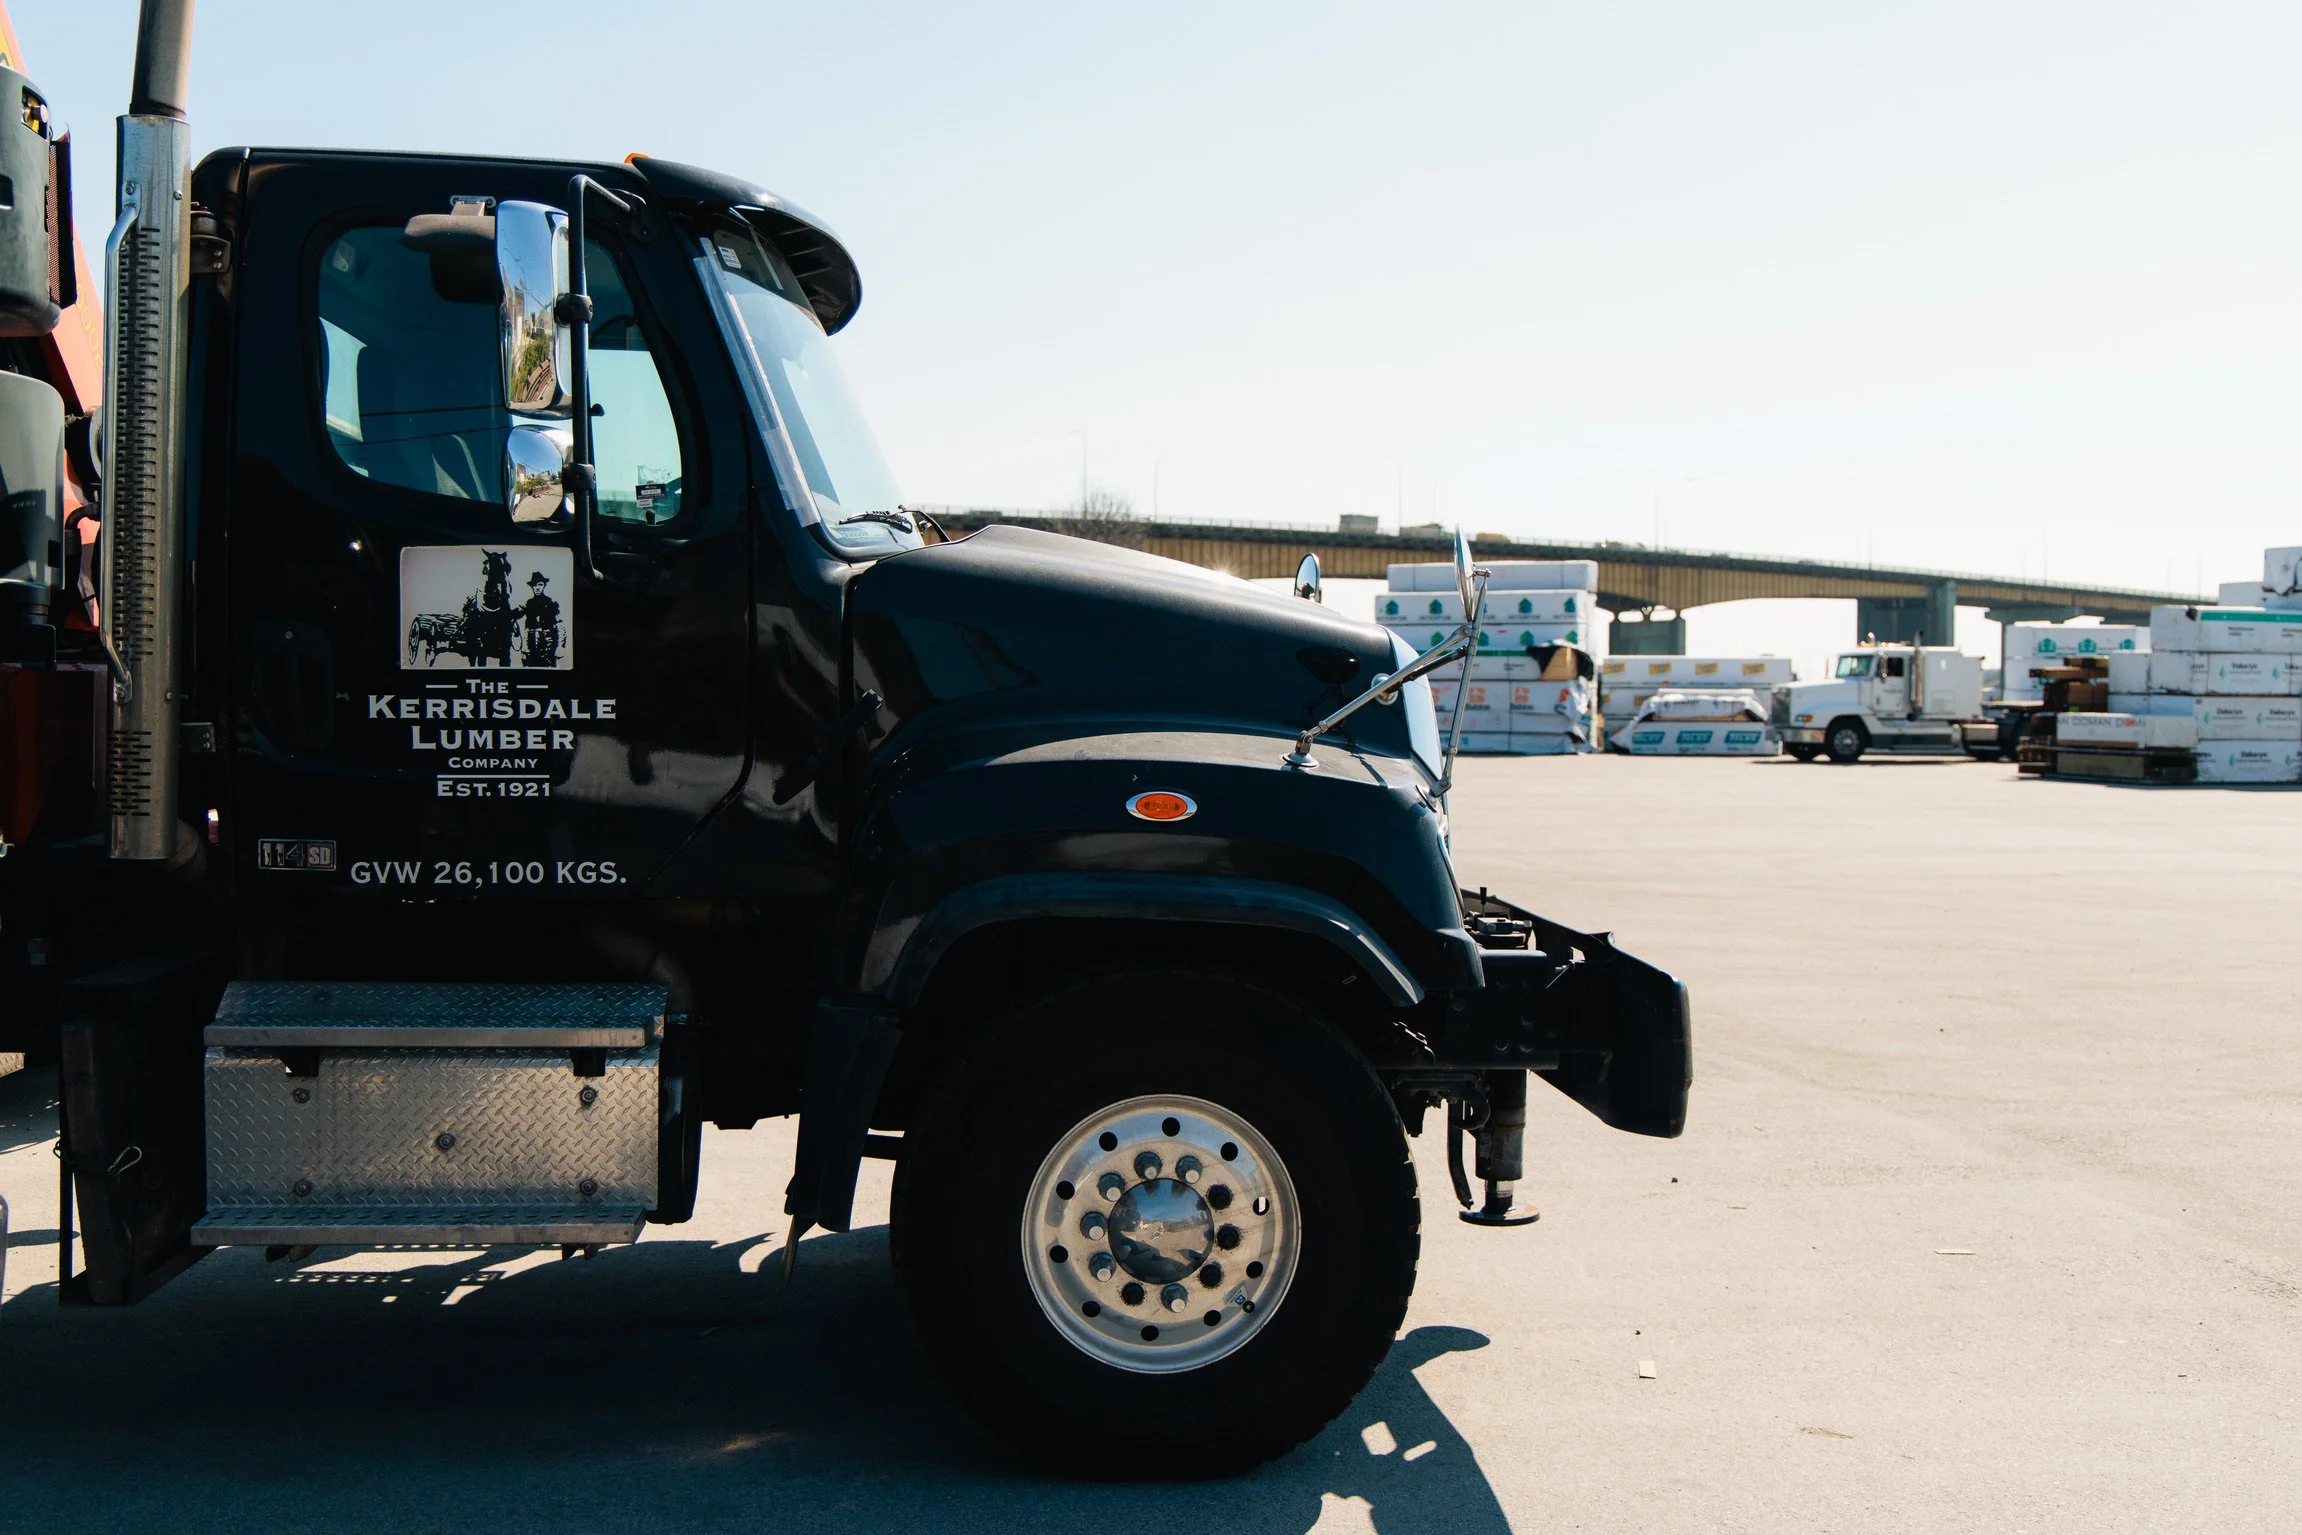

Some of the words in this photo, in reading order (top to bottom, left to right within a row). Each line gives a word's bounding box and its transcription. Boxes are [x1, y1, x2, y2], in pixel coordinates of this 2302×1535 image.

[466, 679, 508, 693] THE
[369, 694, 616, 719] KERRISDALE
[412, 726, 574, 750] LUMBER
[448, 757, 538, 769] COMPANY
[437, 781, 492, 797] EST.
[498, 782, 550, 797] 1921
[351, 862, 421, 884] GVW
[434, 862, 544, 889] 26,100
[557, 862, 627, 884] KGS.
